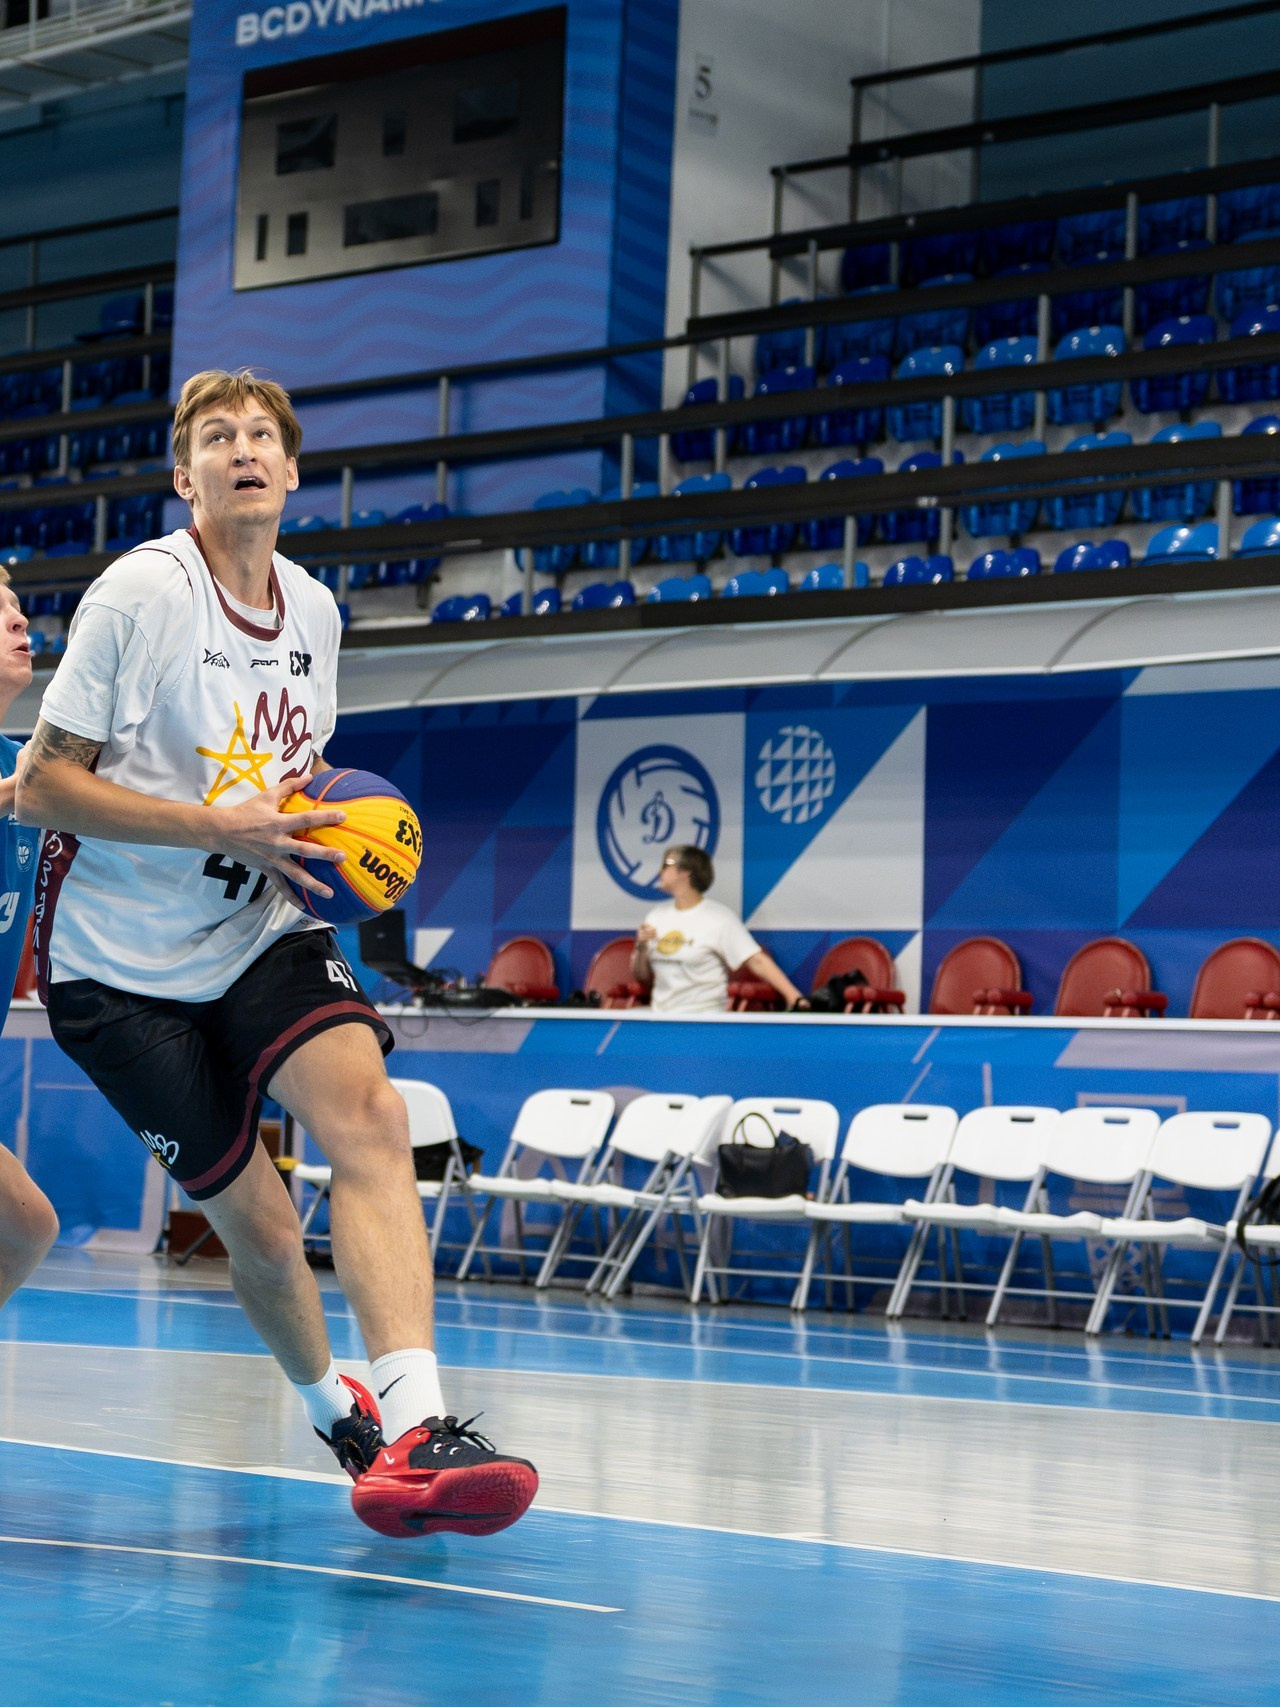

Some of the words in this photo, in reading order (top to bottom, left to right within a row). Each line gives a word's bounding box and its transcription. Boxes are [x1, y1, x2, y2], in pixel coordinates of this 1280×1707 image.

[235, 0, 442, 46] BCDYN
[694, 65, 712, 99] 5
[359, 849, 412, 904] ilson
